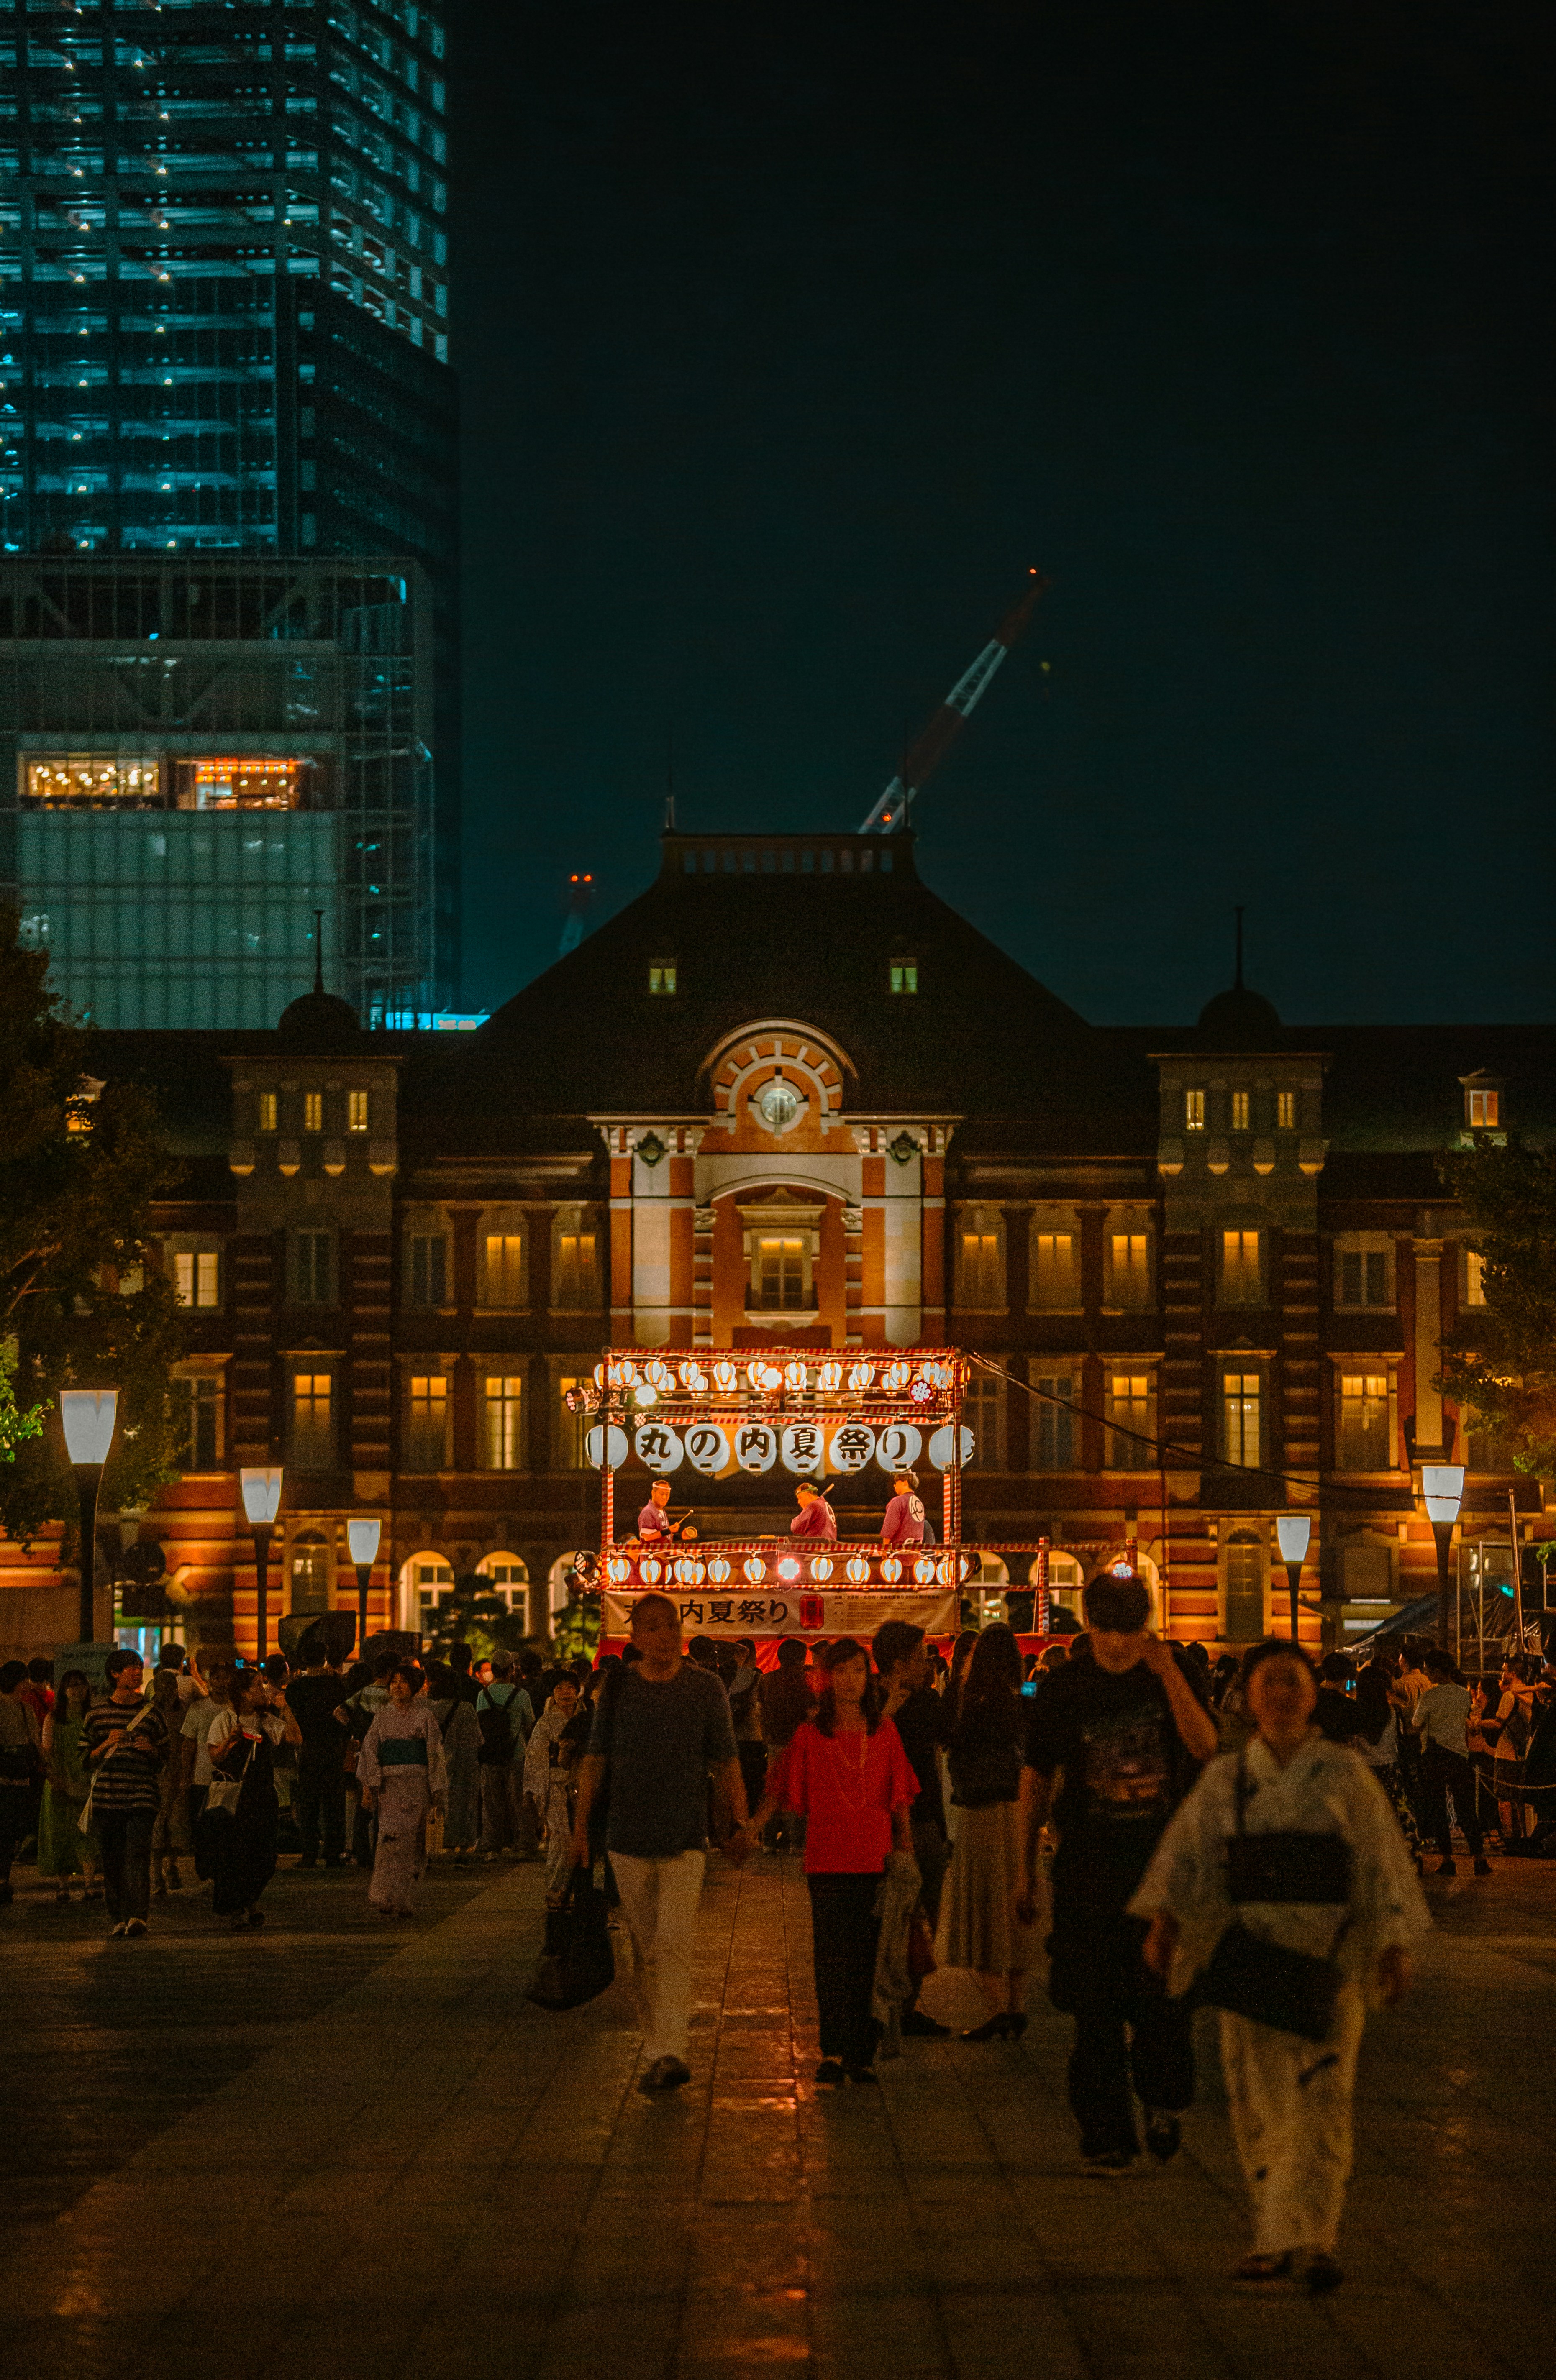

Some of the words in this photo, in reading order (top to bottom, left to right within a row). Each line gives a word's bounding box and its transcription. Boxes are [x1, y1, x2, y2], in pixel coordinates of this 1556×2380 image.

[640, 1427, 907, 1460] 丸の内夏祭り
